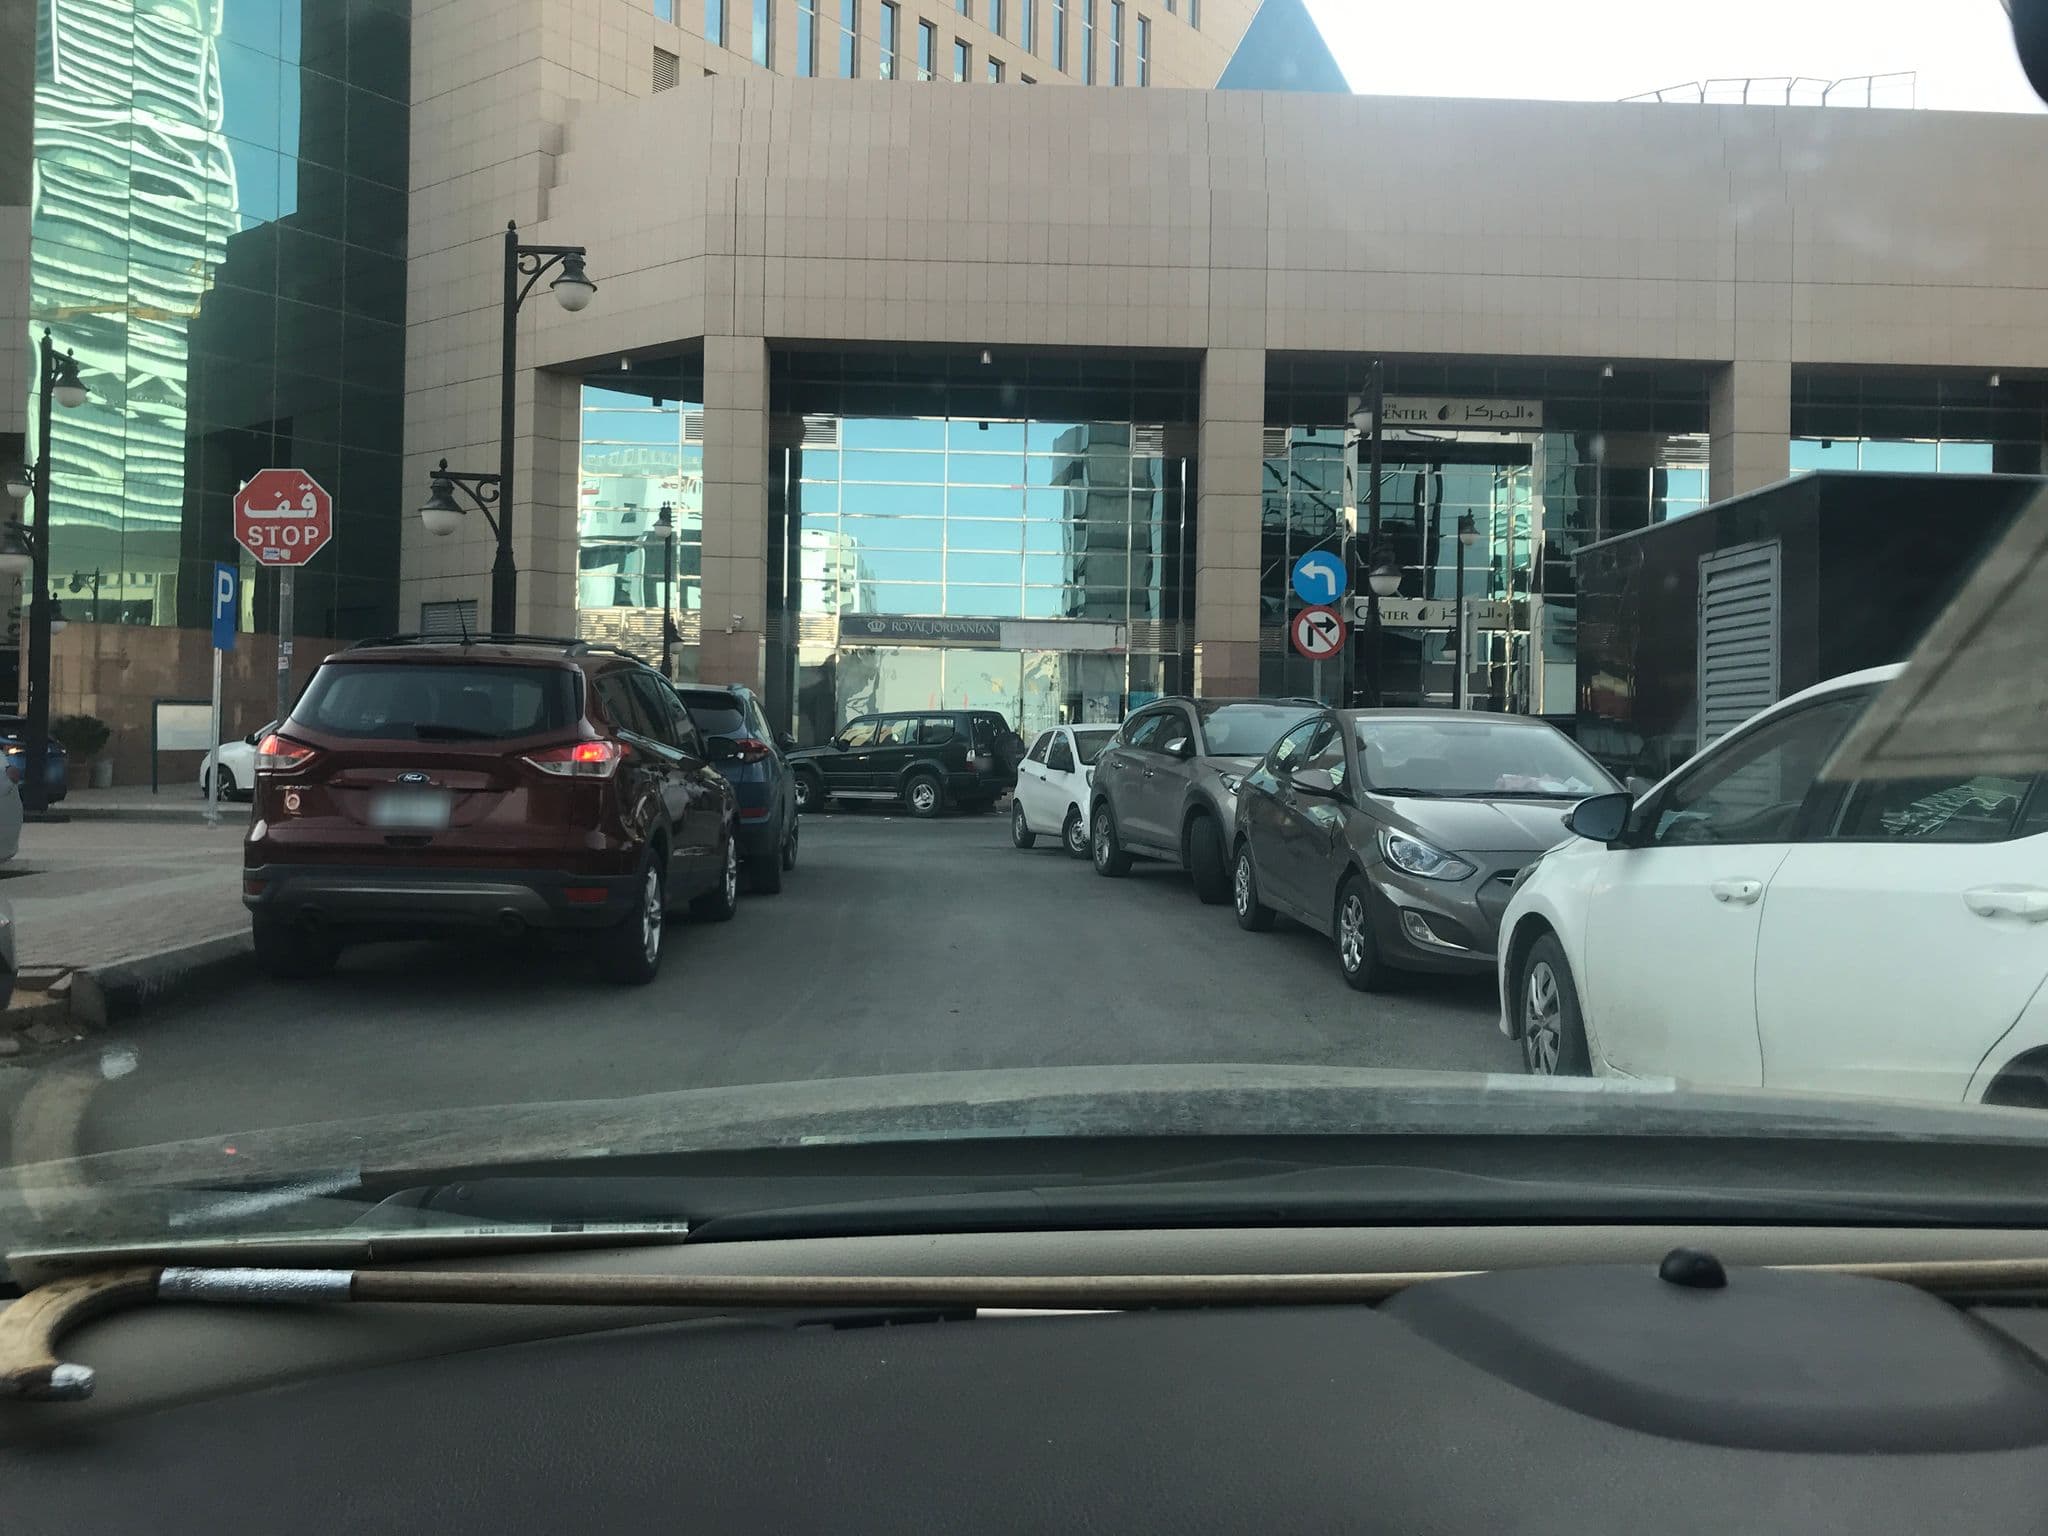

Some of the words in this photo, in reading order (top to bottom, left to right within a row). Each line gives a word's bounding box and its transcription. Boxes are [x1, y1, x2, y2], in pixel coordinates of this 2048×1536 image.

[1382, 409, 1428, 420] ENTER
[1464, 404, 1524, 421] المركز
[243, 483, 318, 519] قف
[247, 525, 319, 546] STOP
[216, 569, 234, 620] P
[1354, 605, 1409, 621] CNTER
[891, 620, 927, 633] ROYAL
[926, 621, 995, 634] JORDANIAN
